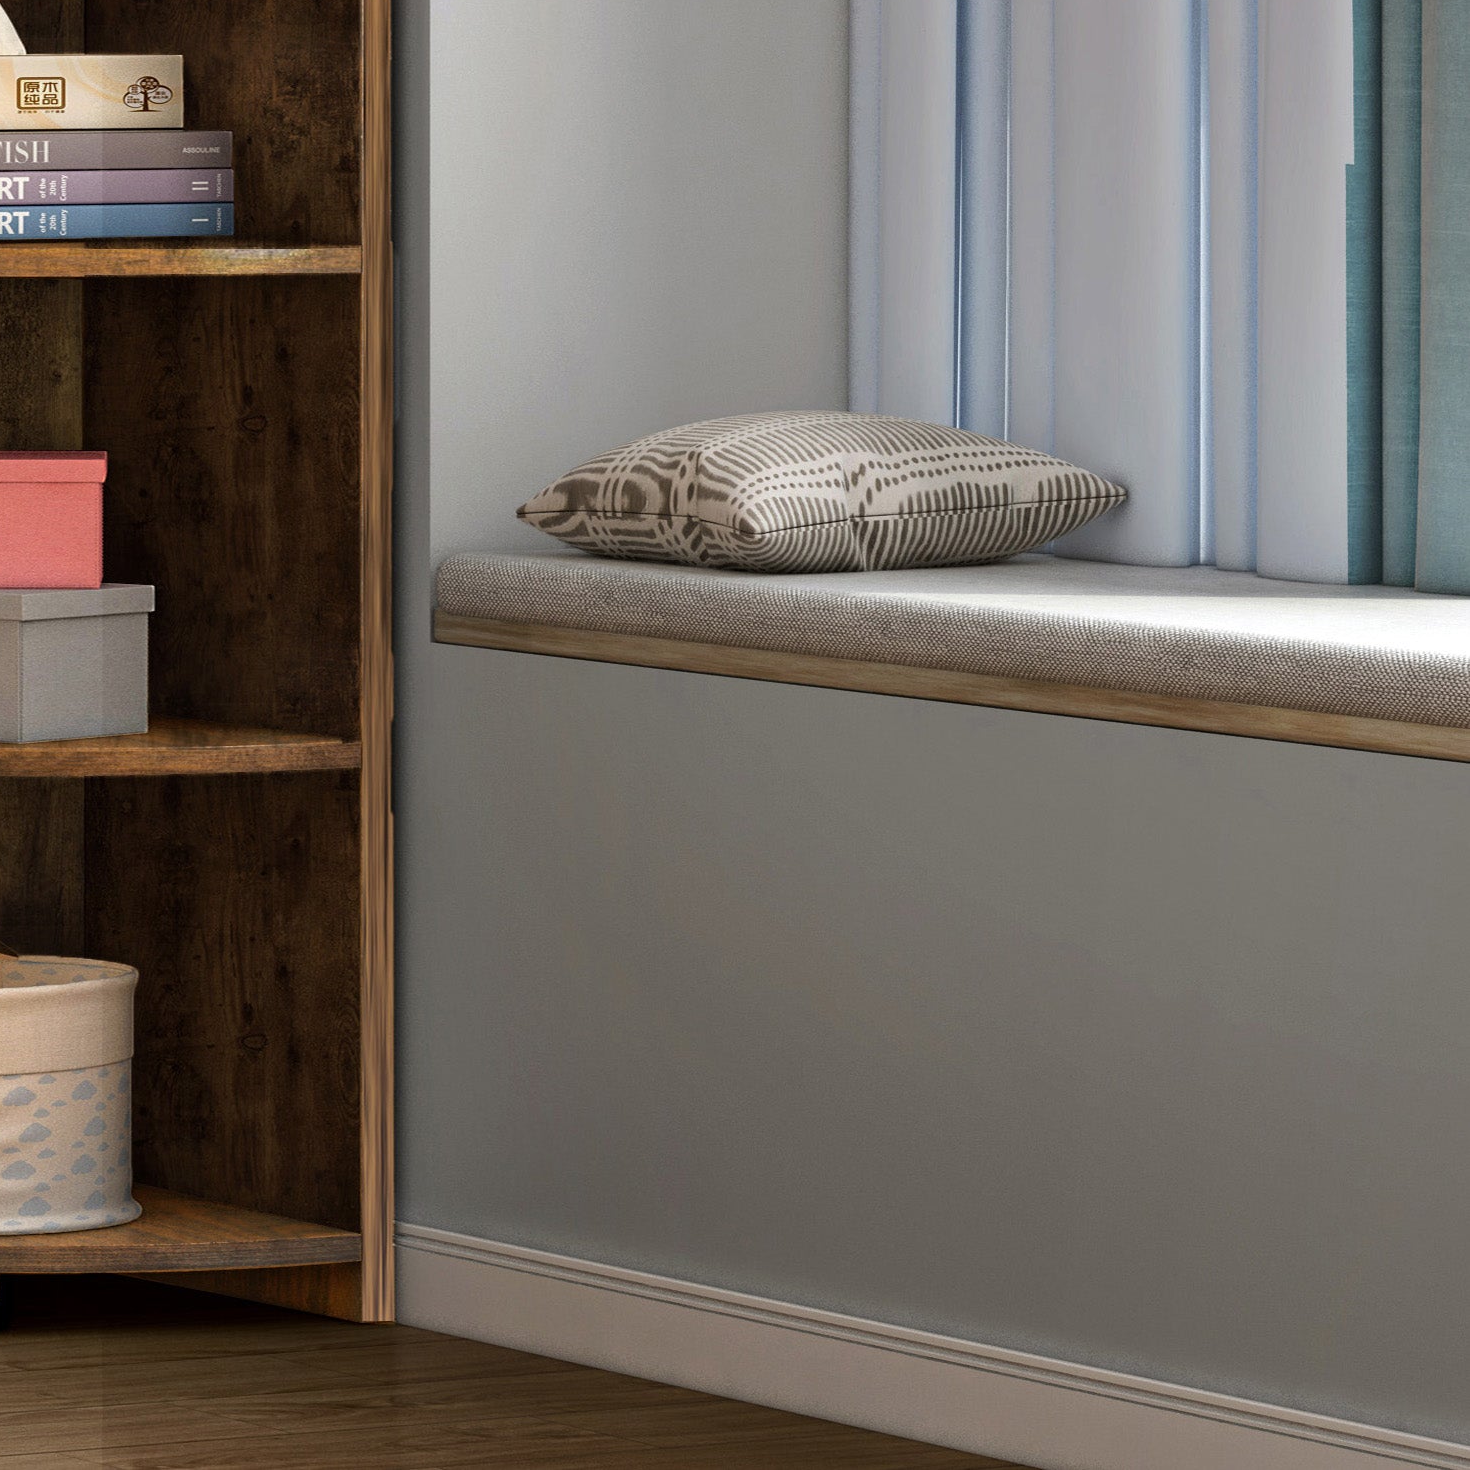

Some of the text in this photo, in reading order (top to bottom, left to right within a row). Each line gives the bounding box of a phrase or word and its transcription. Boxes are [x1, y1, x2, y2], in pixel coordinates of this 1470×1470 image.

[23, 81, 59, 93] 原木
[23, 93, 59, 106] 纯品
[182, 146, 221, 154] ASSOULINE
[39, 178, 47, 199] of the
[49, 180, 57, 196] 20th
[59, 174, 68, 201] Century
[39, 212, 47, 233] of the
[49, 214, 57, 231] 20th
[59, 209, 68, 236] Century
